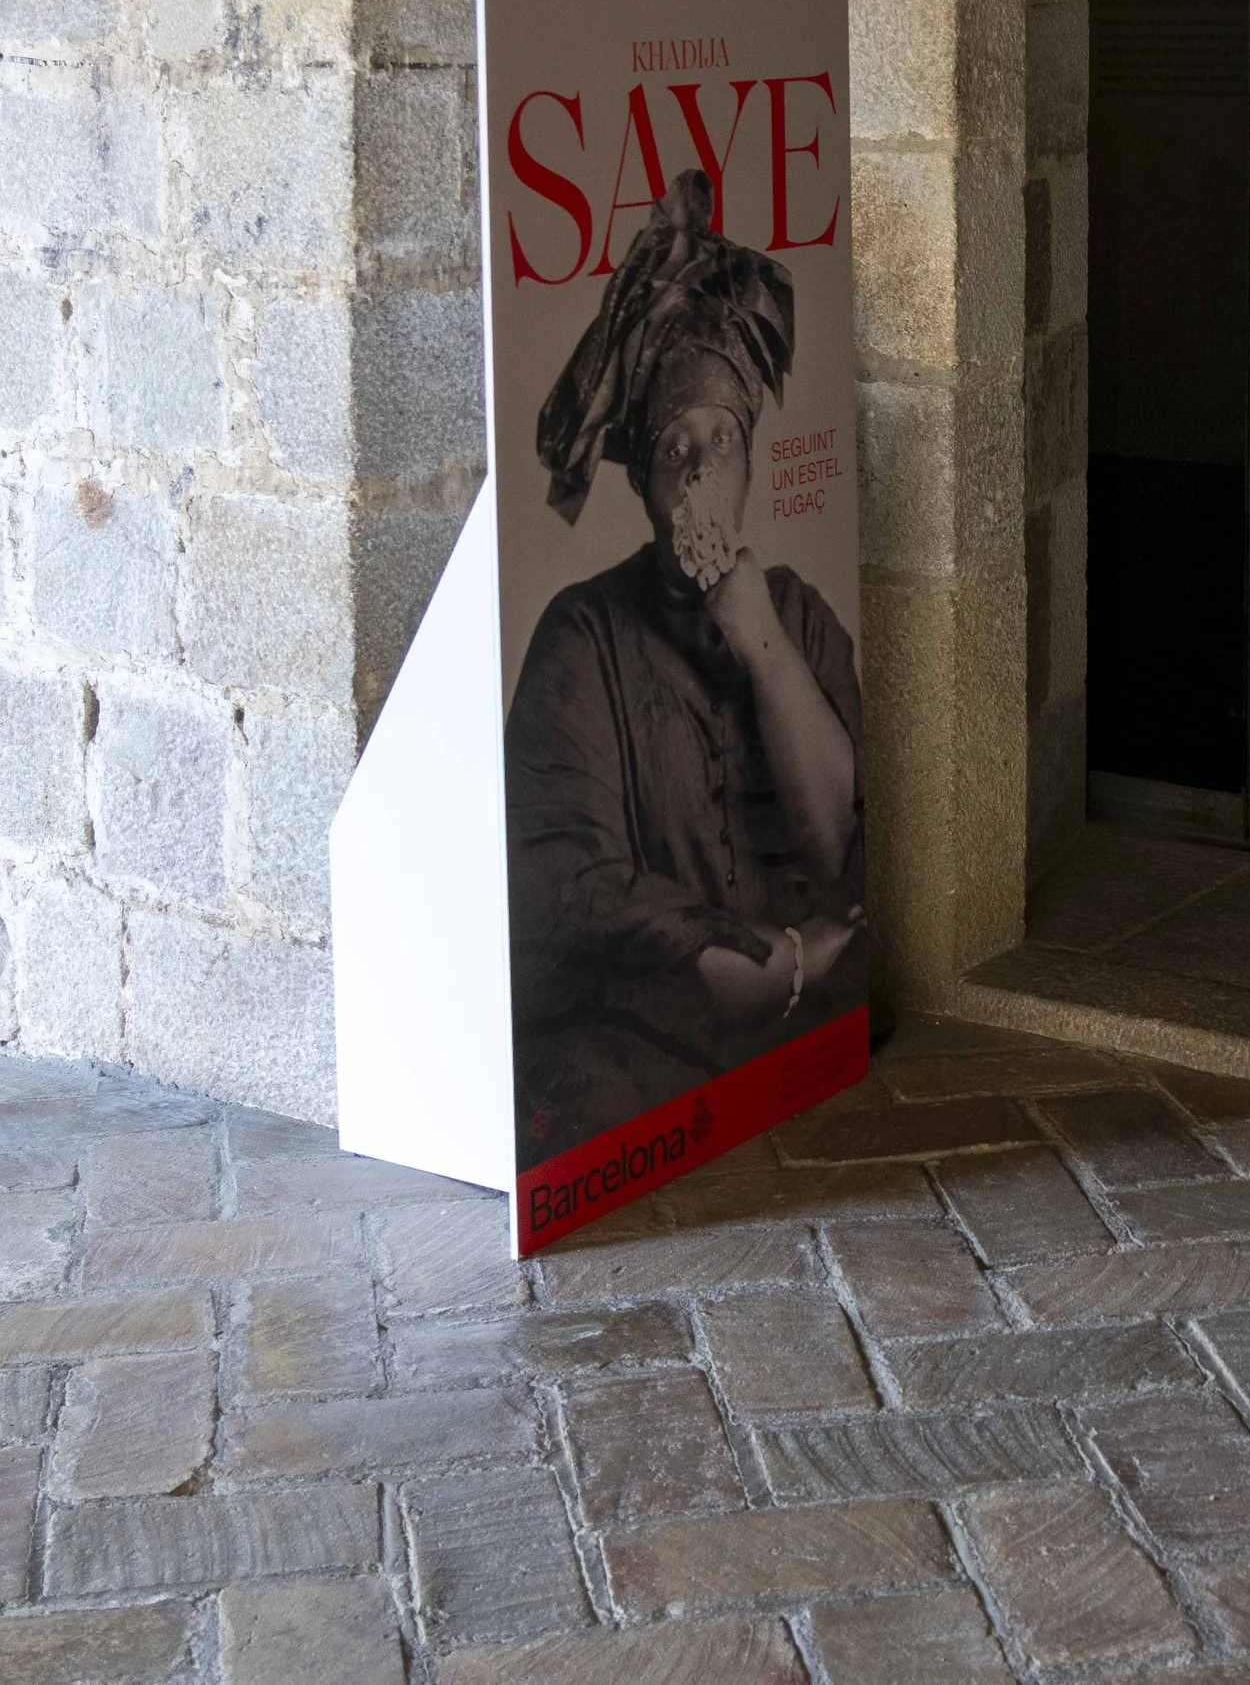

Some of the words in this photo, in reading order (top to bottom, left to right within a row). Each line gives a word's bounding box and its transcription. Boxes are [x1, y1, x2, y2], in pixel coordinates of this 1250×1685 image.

[632, 37, 730, 73] KHADIJA
[507, 71, 841, 289] SAYE
[771, 428, 837, 462] SEGUINT
[772, 467, 794, 491] UN
[798, 457, 843, 486] ESTEL
[773, 488, 826, 521] FUGAÇ
[529, 1125, 686, 1233] Barcelona
